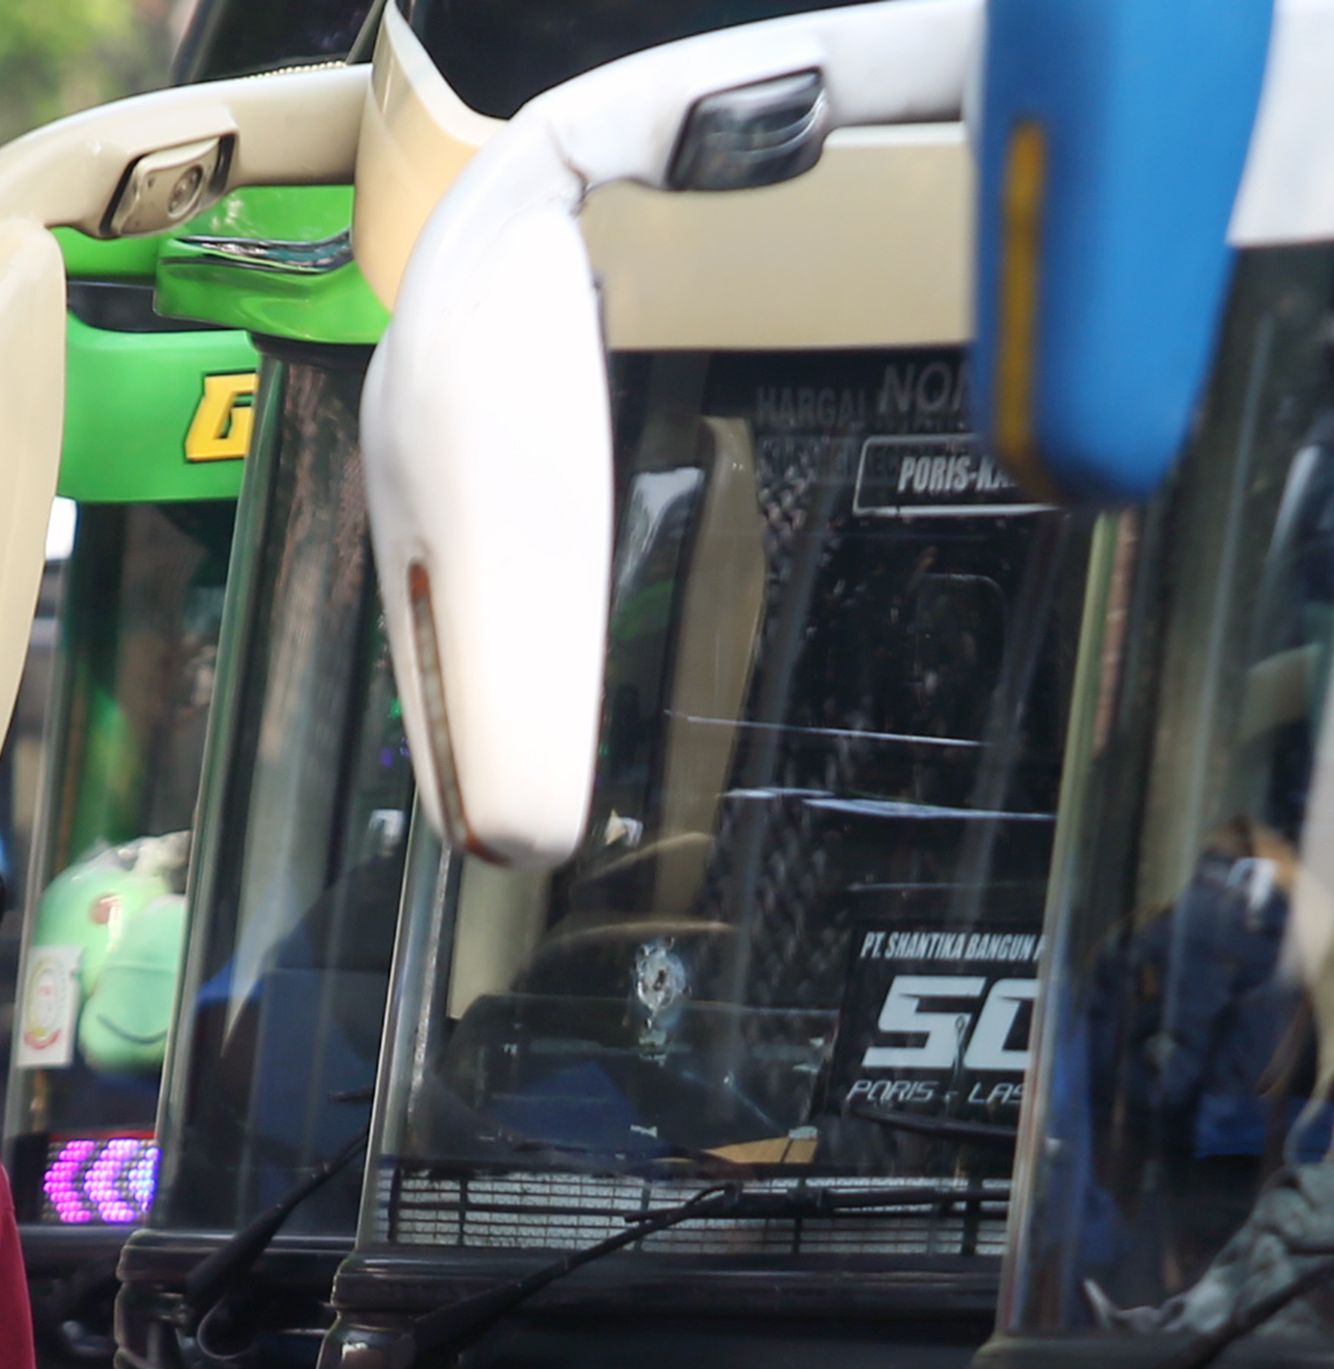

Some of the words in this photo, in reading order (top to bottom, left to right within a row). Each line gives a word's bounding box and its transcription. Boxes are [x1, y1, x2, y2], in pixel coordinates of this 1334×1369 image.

[884, 932, 965, 960] SHANTIKA
[966, 933, 1036, 961] BANGUN
[846, 1079, 939, 1102] PORIS
